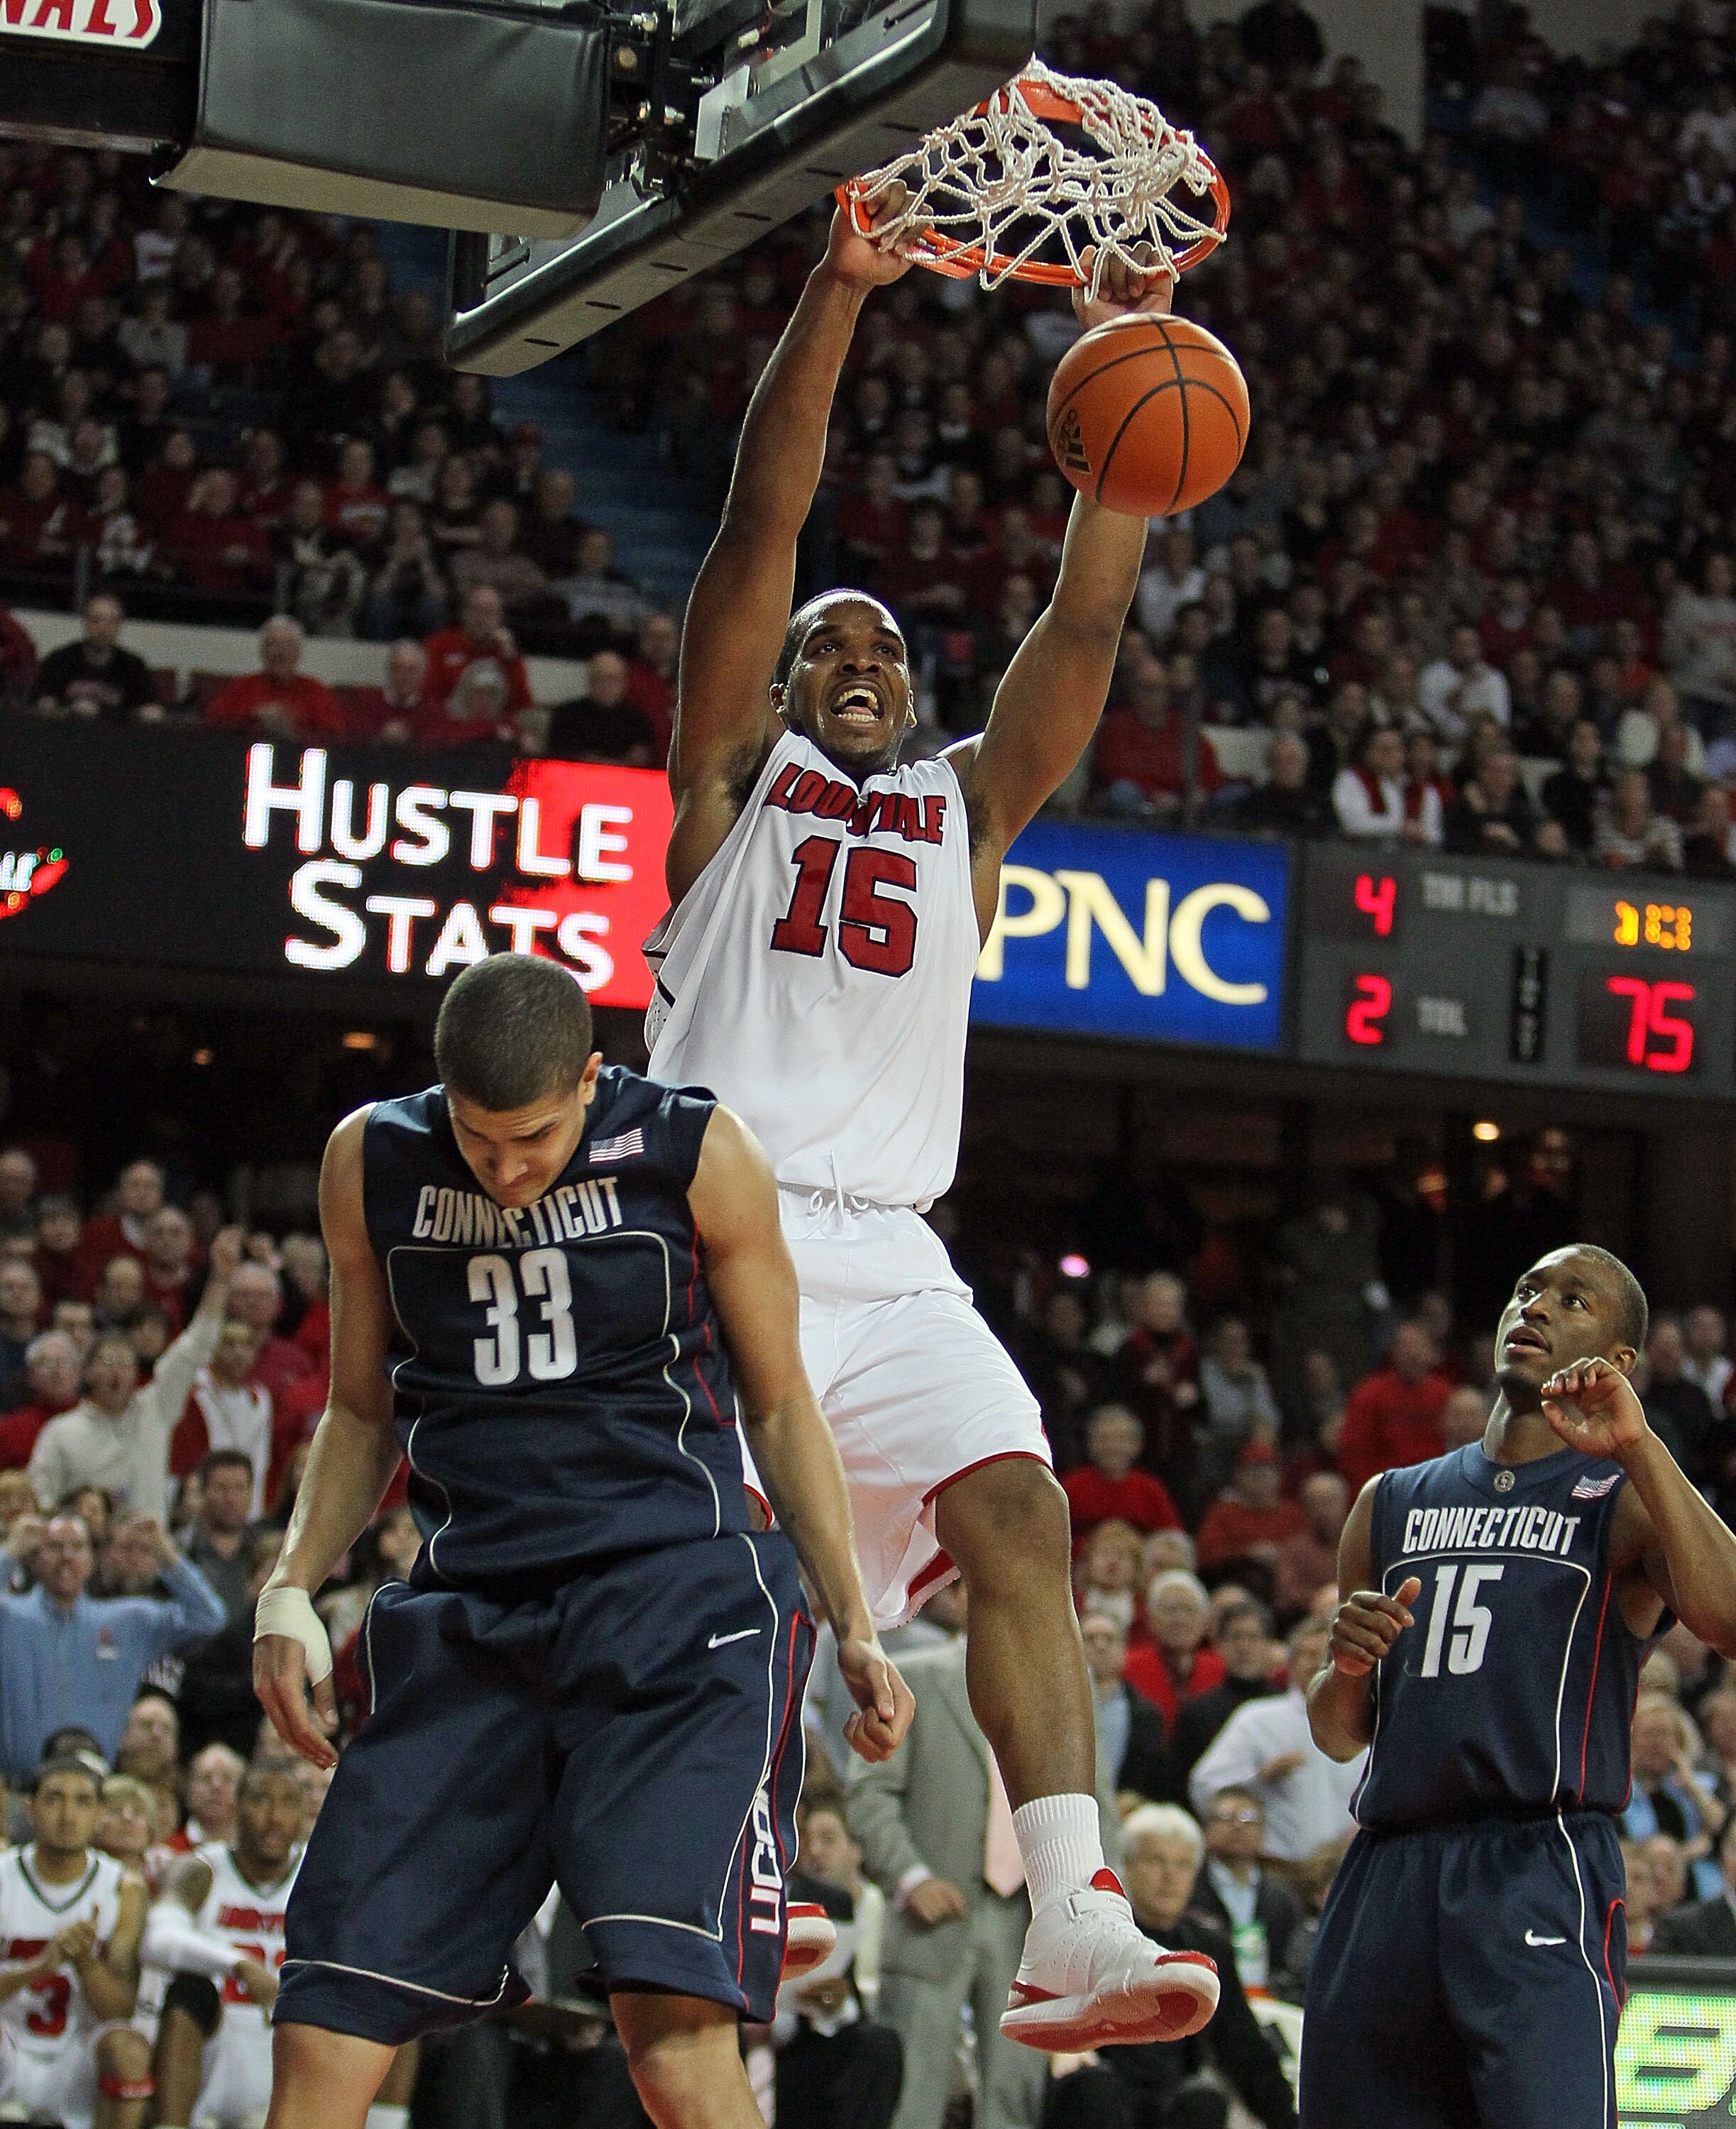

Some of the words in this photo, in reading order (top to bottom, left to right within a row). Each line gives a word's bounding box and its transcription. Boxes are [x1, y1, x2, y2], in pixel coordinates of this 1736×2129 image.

[284, 859, 615, 993] STATS
[770, 834, 918, 979] 15
[975, 864, 1272, 1006] PNC
[1355, 874, 1395, 936] 4
[1348, 974, 1392, 1045] 2
[1605, 975, 1696, 1072] 75
[412, 1176, 622, 1248] CONNECTICUT
[466, 1247, 578, 1386] 33
[1402, 1505, 1581, 1556] CONNECTICUT
[1420, 1564, 1505, 1678] 15
[27, 1973, 70, 2036] 3
